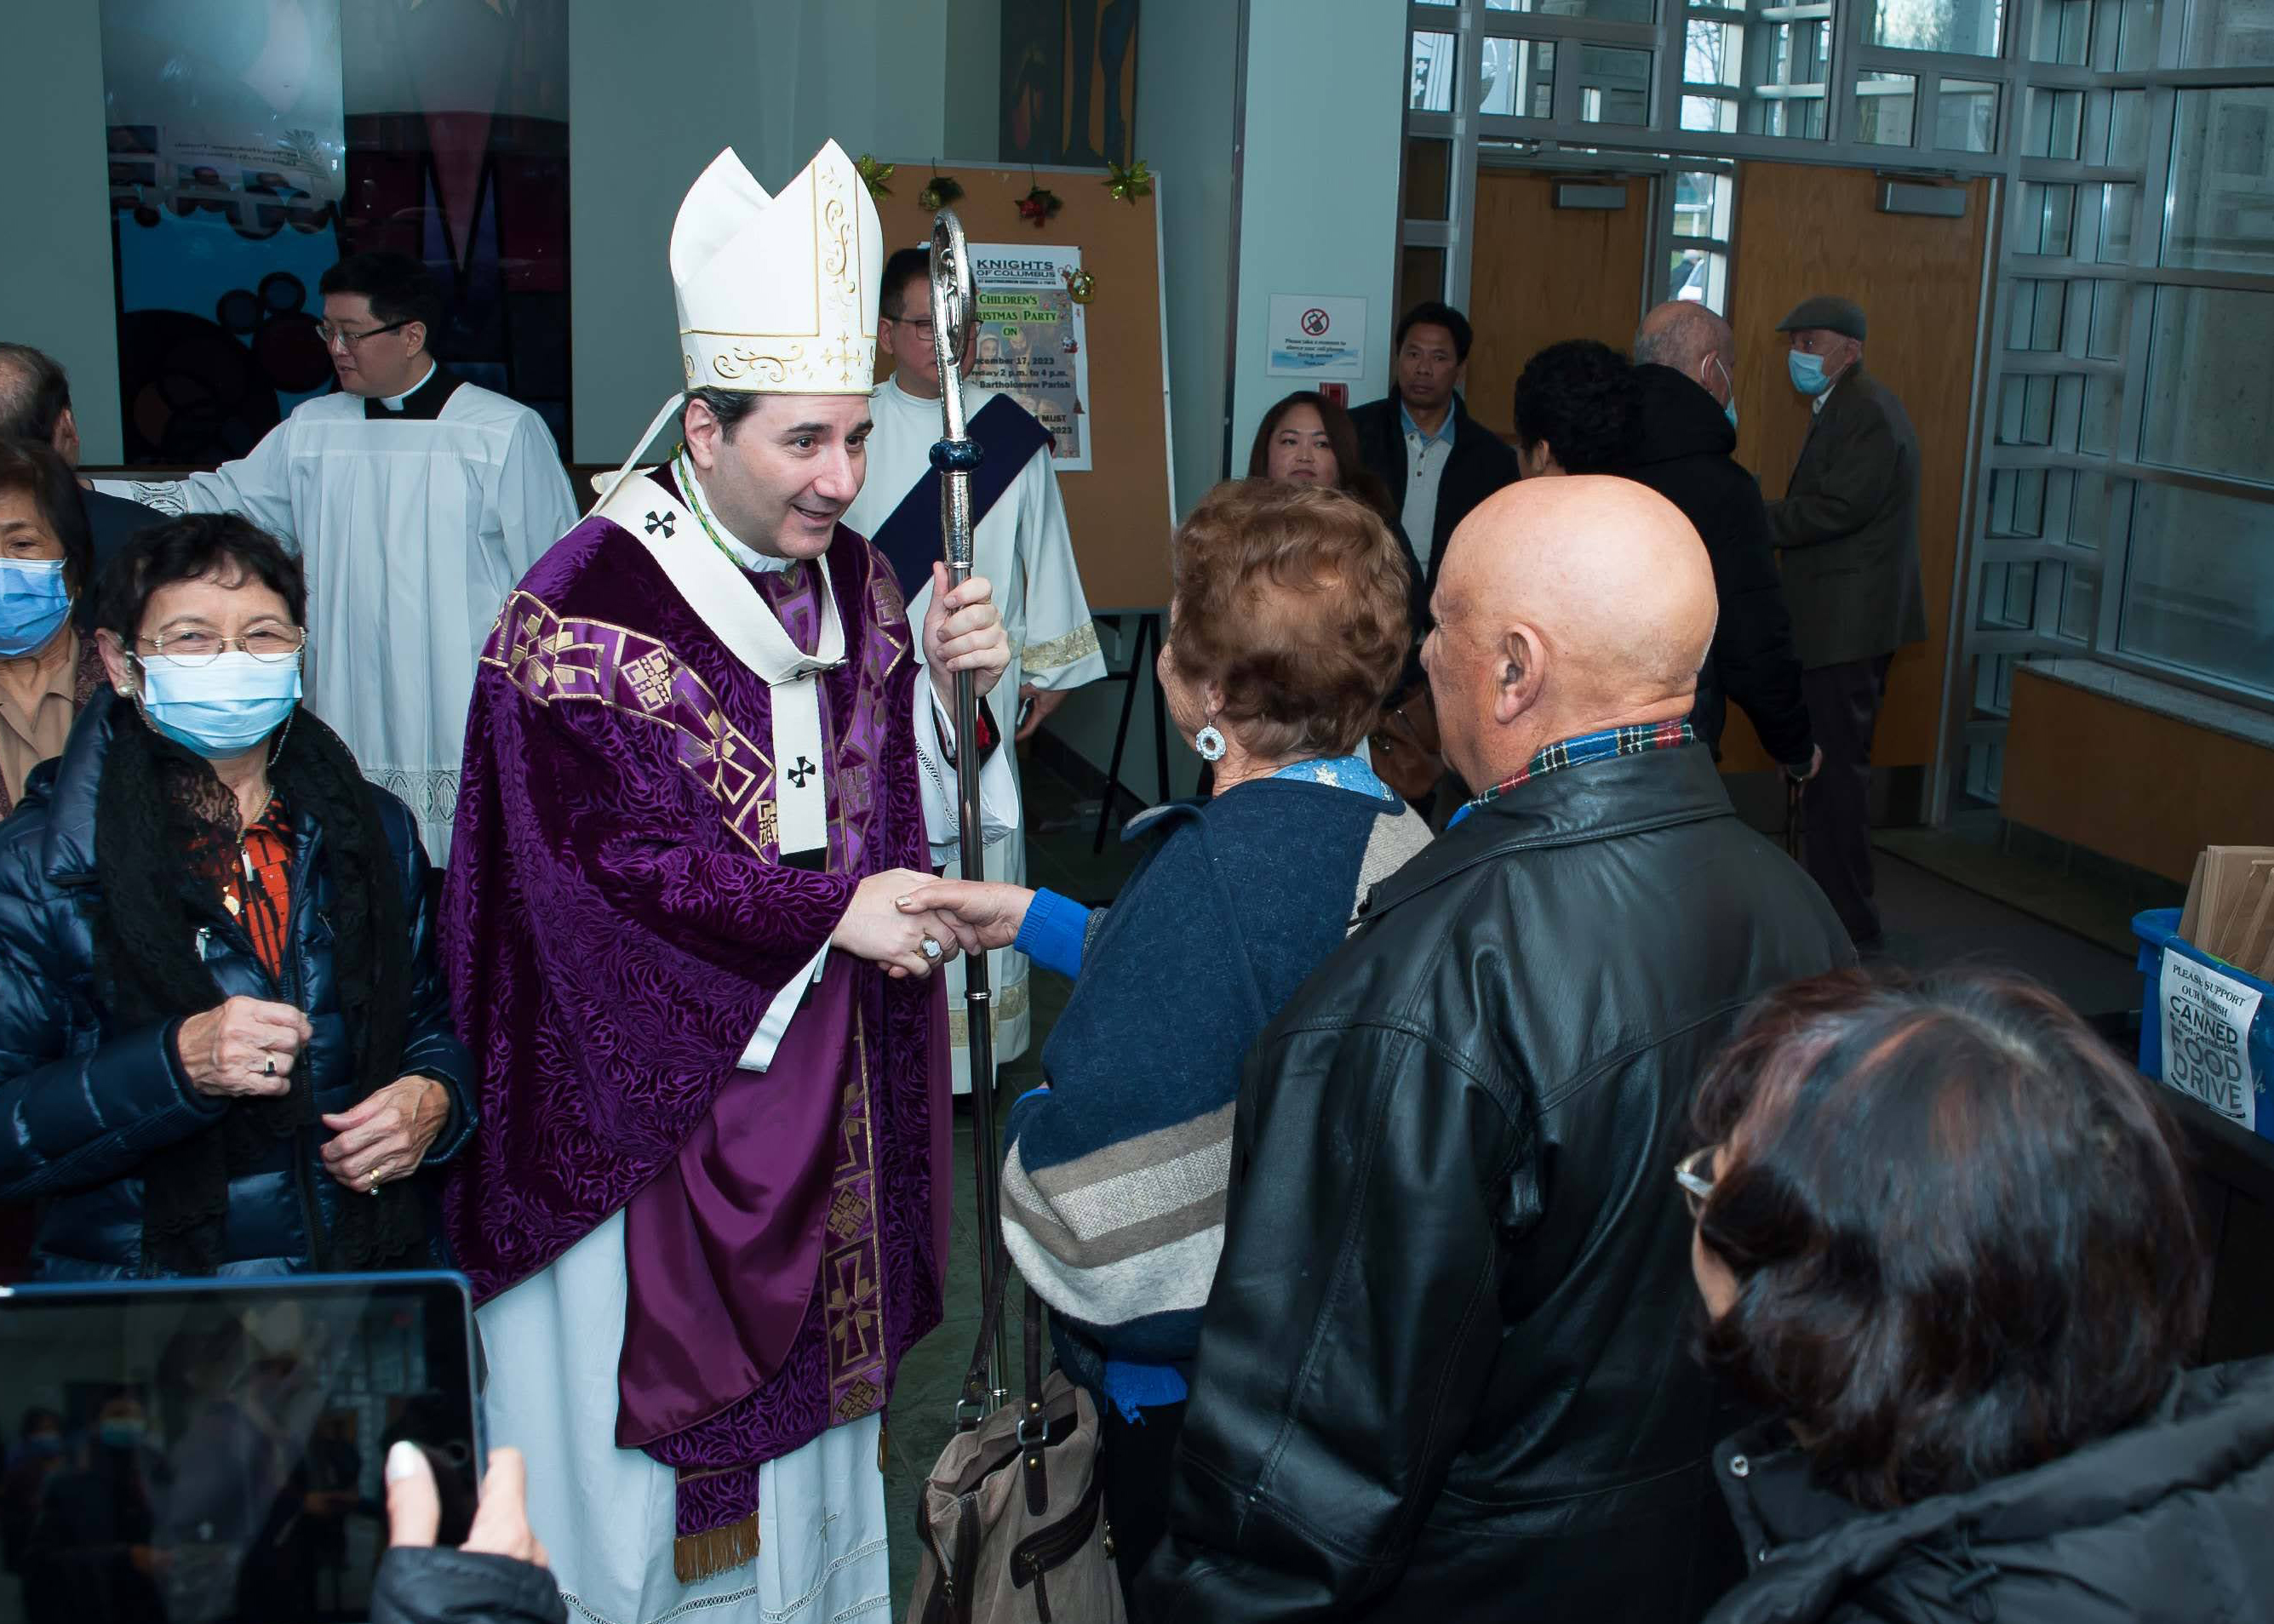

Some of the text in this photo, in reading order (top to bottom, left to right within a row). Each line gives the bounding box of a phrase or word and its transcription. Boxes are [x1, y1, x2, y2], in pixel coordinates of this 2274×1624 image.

[977, 260, 1054, 270] KNIGHTS
[994, 270, 1056, 278] COLUMBUS
[1023, 311, 1057, 321] PARTY
[1003, 327, 1017, 336] ON
[1032, 357, 1055, 365] 2023
[2173, 964, 2245, 1007] PLEASE SUPPORT
[2182, 985, 2228, 1018] OUR PARISH
[2170, 995, 2238, 1044] CANNED
[2171, 1024, 2242, 1082] FOOD
[2173, 1050, 2242, 1110] DRIVE
